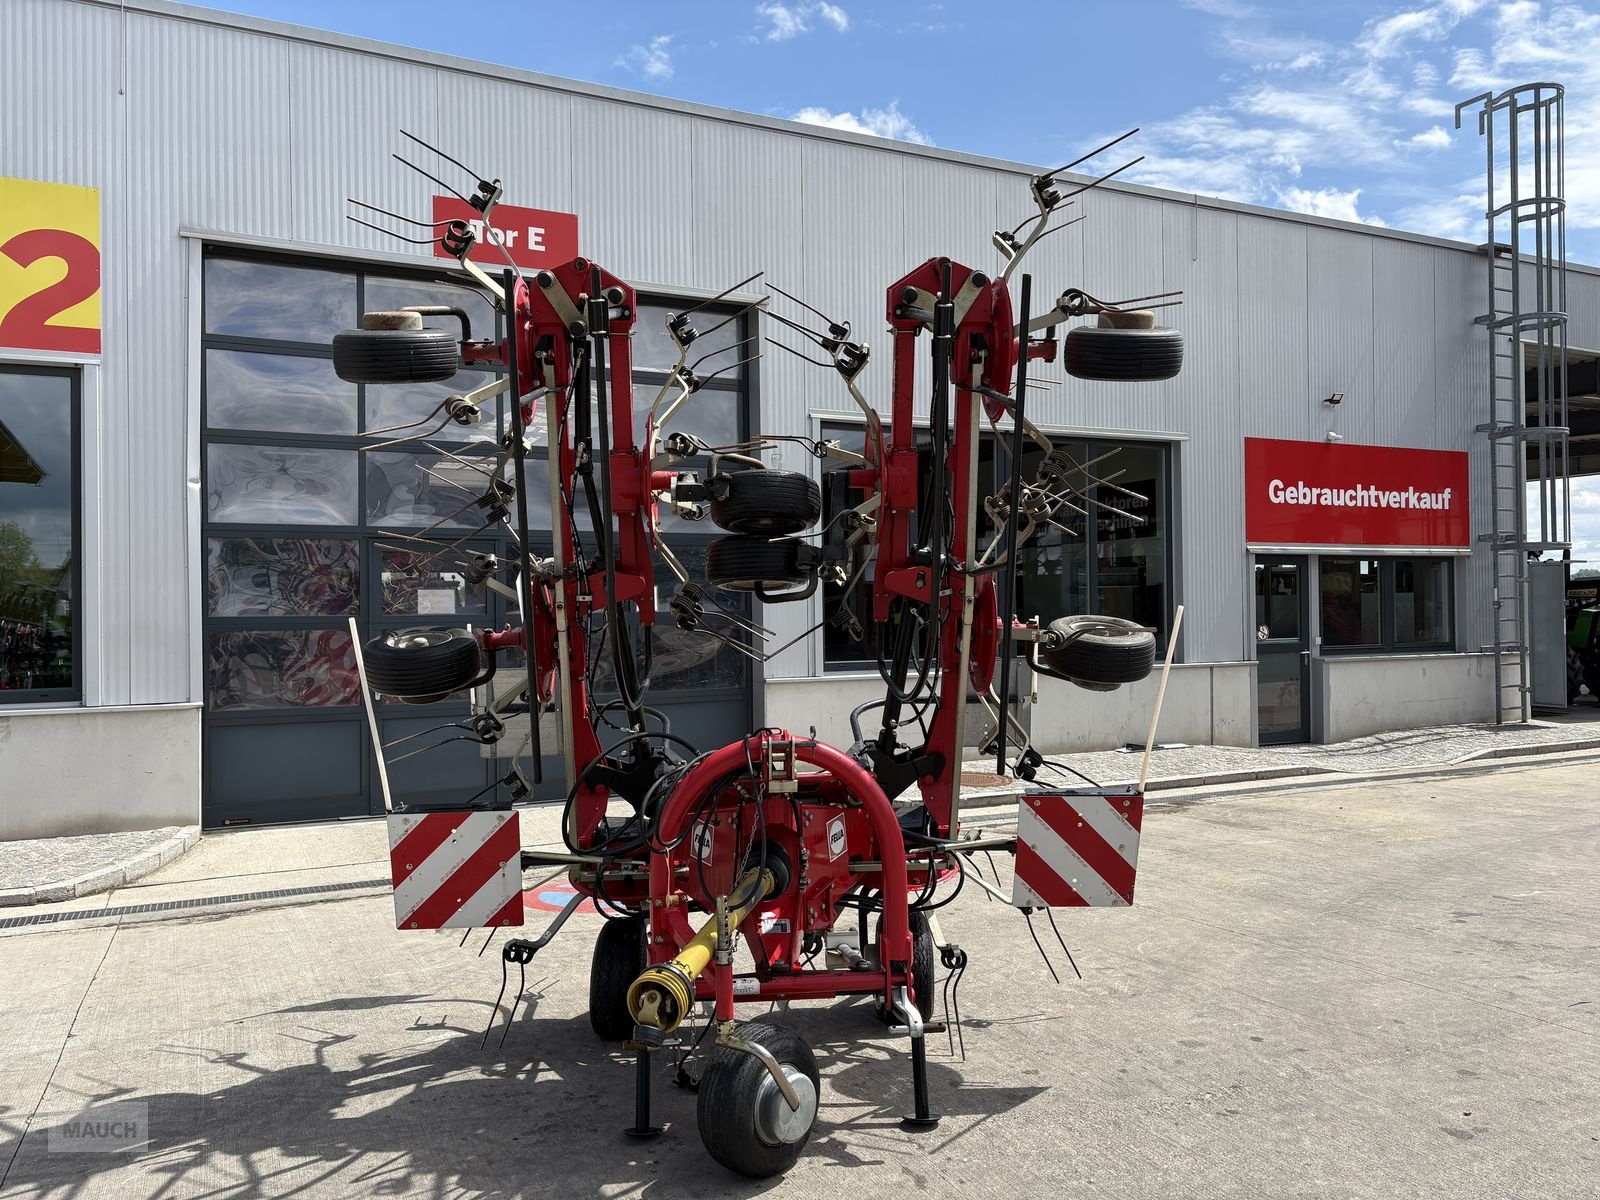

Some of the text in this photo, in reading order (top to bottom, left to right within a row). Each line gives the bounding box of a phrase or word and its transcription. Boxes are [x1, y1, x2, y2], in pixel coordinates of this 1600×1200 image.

[469, 219, 546, 252] Tor E
[1268, 479, 1452, 510] Gebrauchtverkauf
